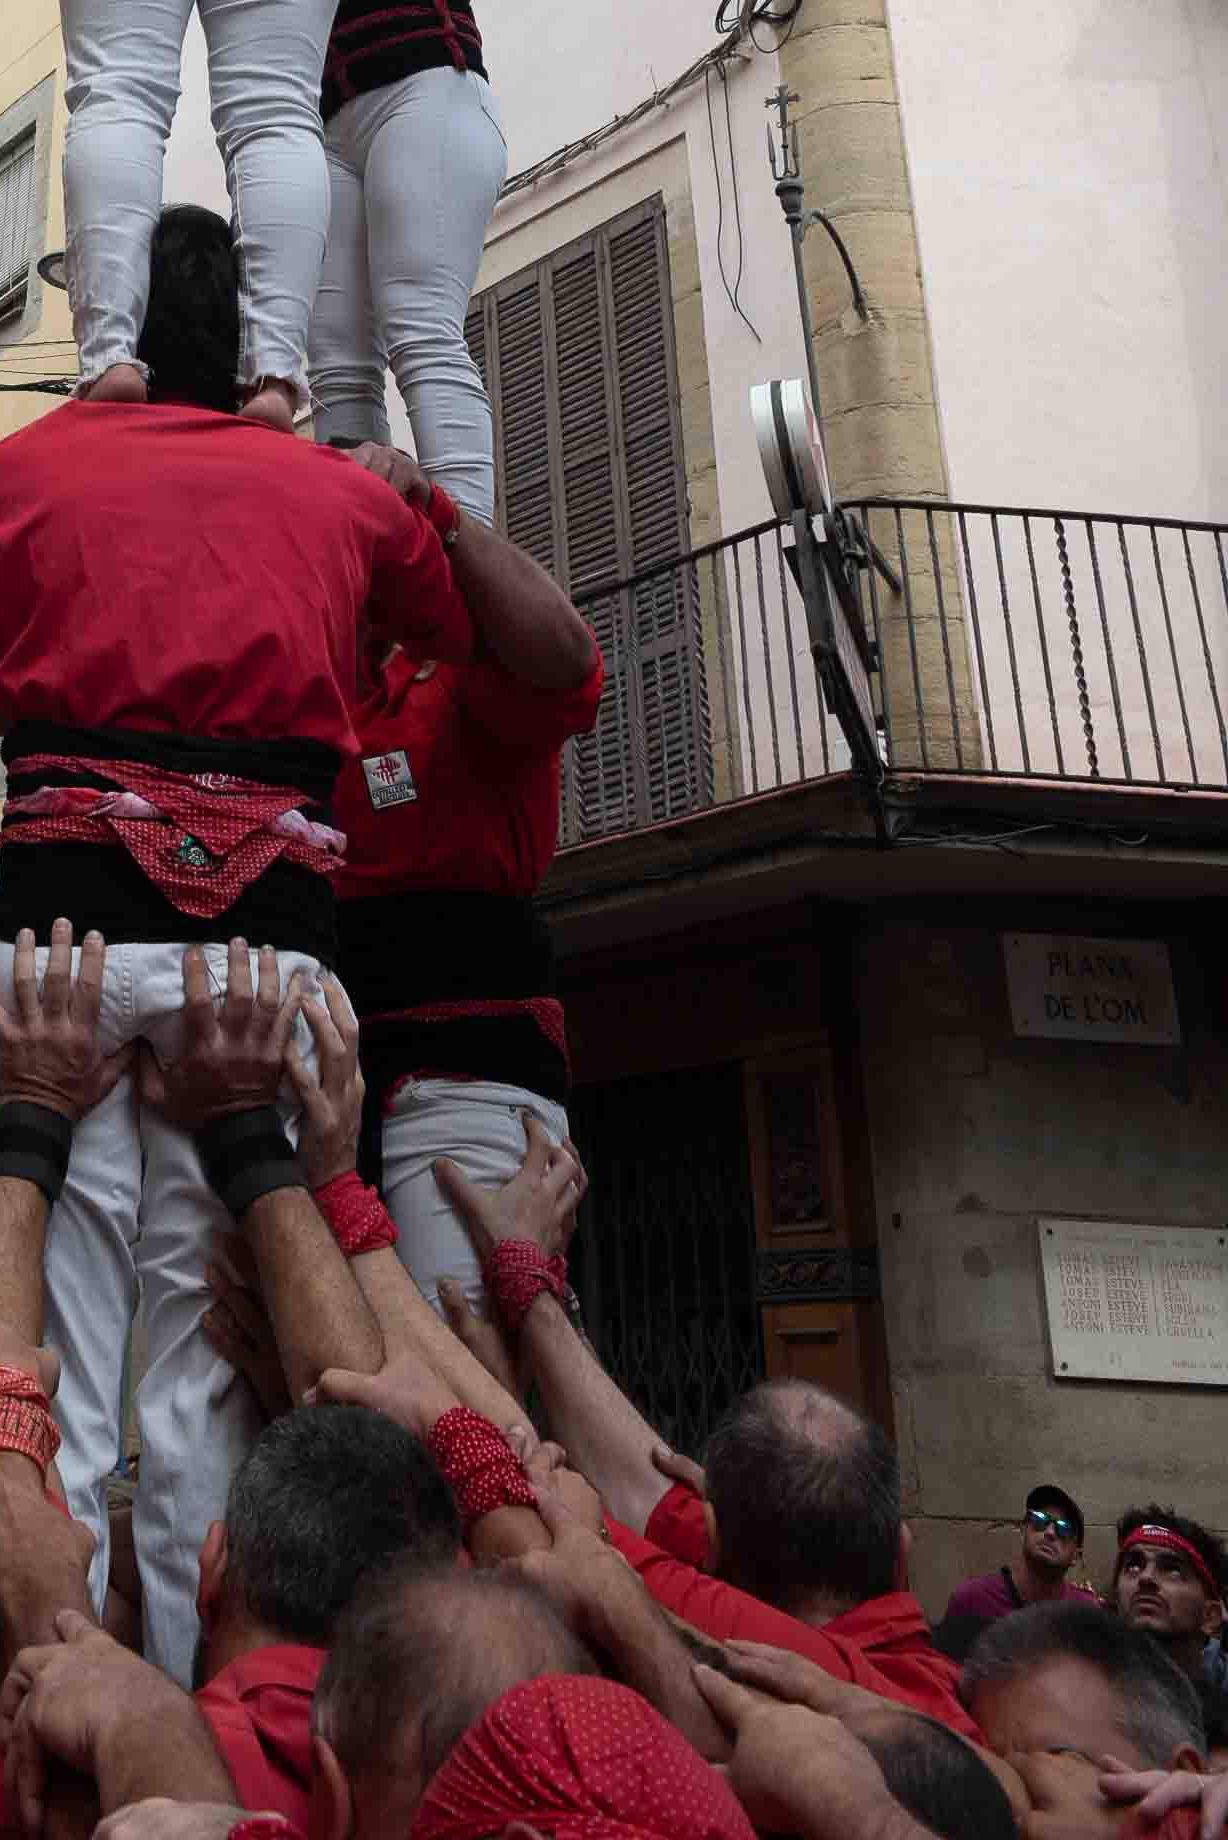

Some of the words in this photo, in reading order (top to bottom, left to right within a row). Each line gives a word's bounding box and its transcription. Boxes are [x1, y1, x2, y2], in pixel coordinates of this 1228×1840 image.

[1043, 993, 1076, 1020] DE
[1084, 992, 1148, 1025] L'OM
[1107, 1300, 1149, 1313] ESTEVE
